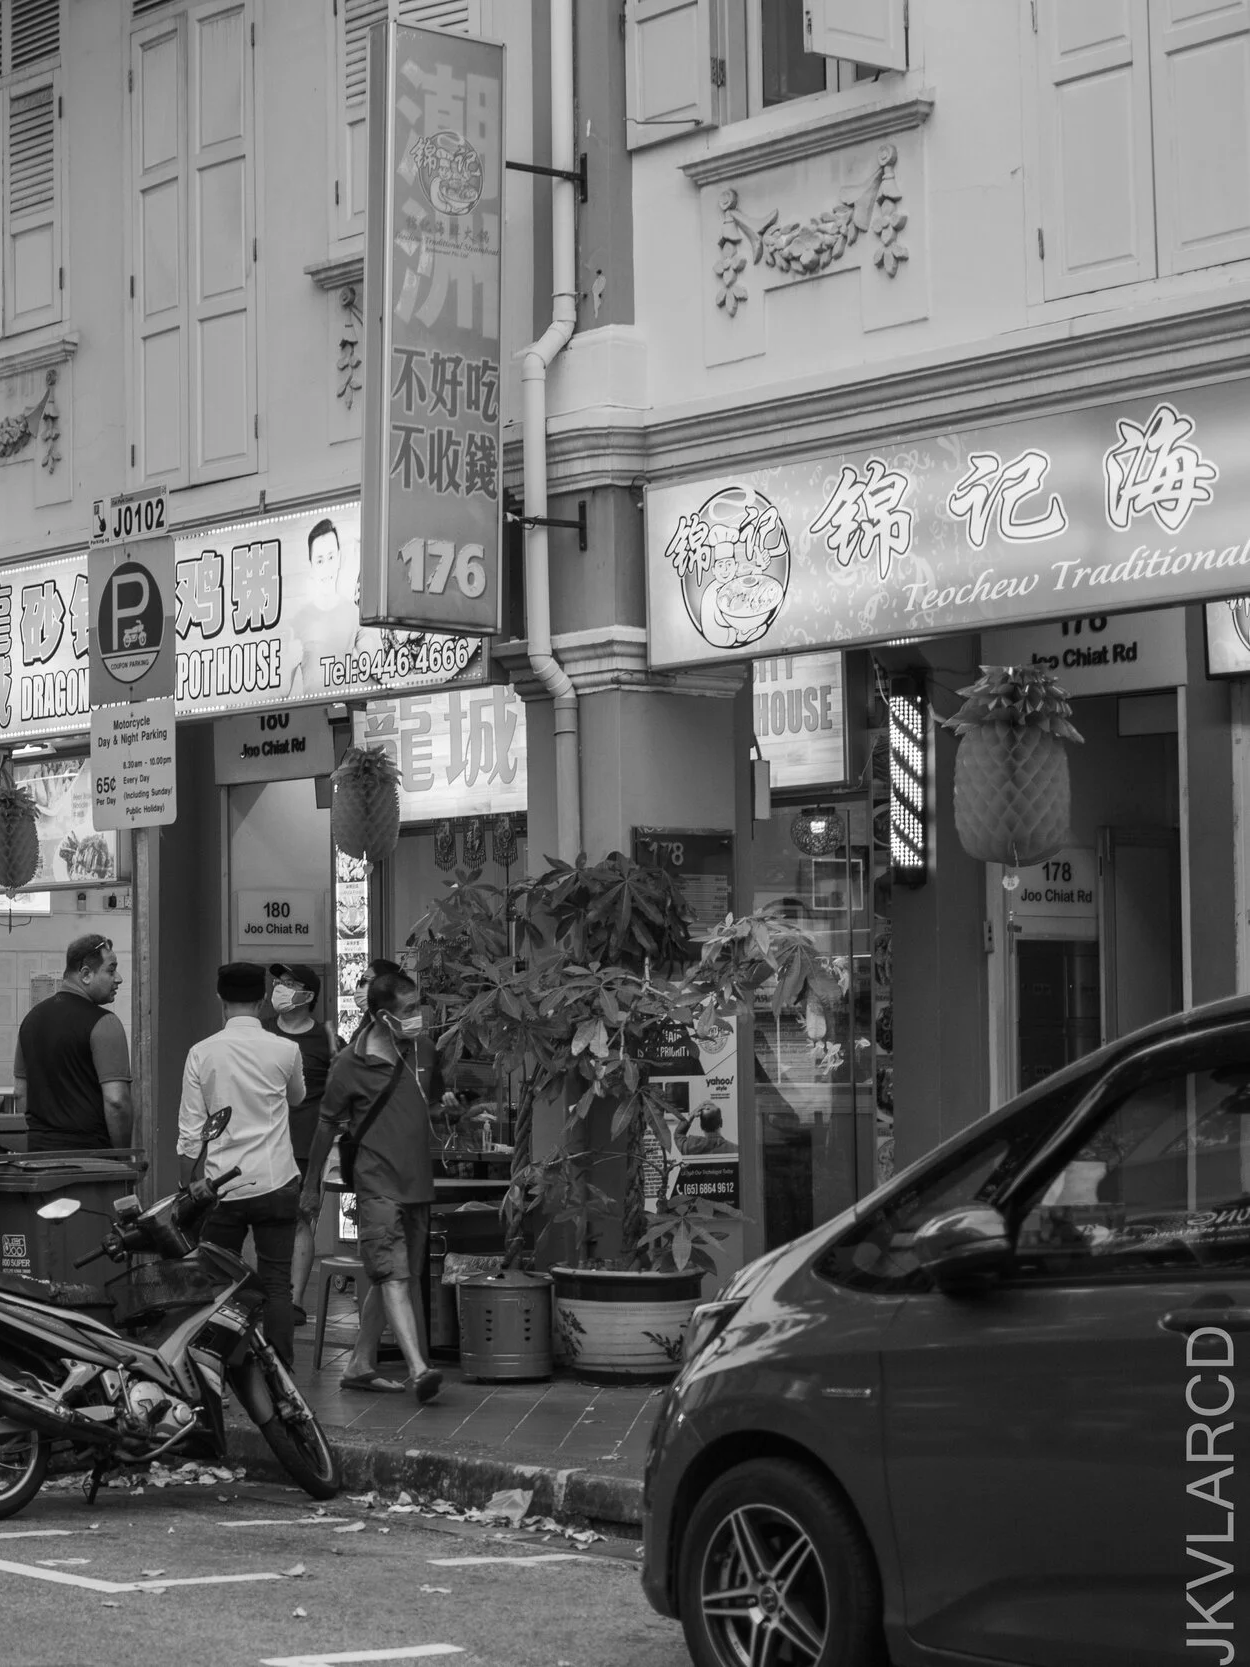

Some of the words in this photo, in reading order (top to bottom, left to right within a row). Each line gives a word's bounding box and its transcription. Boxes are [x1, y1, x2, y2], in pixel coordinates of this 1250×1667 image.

[391, 347, 499, 424] 不好吃
[113, 498, 165, 538] J0102
[398, 537, 486, 598] 176
[900, 568, 1040, 612] Teochew
[1049, 536, 1250, 592] Traditional
[112, 572, 150, 650] P
[111, 661, 128, 670] COUPON
[129, 658, 150, 668] PARKING
[414, 638, 470, 675] 4666
[1063, 645, 1110, 668] Chiat
[1112, 641, 1138, 664] Rd
[216, 638, 282, 695] HOUSE
[753, 685, 833, 737] HOUSE
[113, 716, 150, 730] Motorcycle
[98, 737, 111, 749] Day
[120, 732, 139, 745] Night
[141, 729, 167, 741] Parking
[240, 742, 260, 759] Joo
[261, 739, 290, 757] Chiat
[290, 737, 306, 753] Rd
[123, 776, 138, 785] Every
[139, 774, 150, 784] Day
[106, 796, 116, 806] Day
[126, 807, 142, 815] Public
[1042, 862, 1072, 882] 178
[1021, 889, 1043, 902] Joo
[1044, 889, 1075, 903] Chiat
[1077, 890, 1093, 903] Rd
[262, 902, 291, 919] 180
[244, 923, 264, 935] Joo
[265, 923, 293, 935] Chiat
[294, 923, 309, 935] Rd
[706, 1075, 734, 1087] yahoo!
[699, 1183, 716, 1194] 6864
[717, 1182, 734, 1193] 9612
